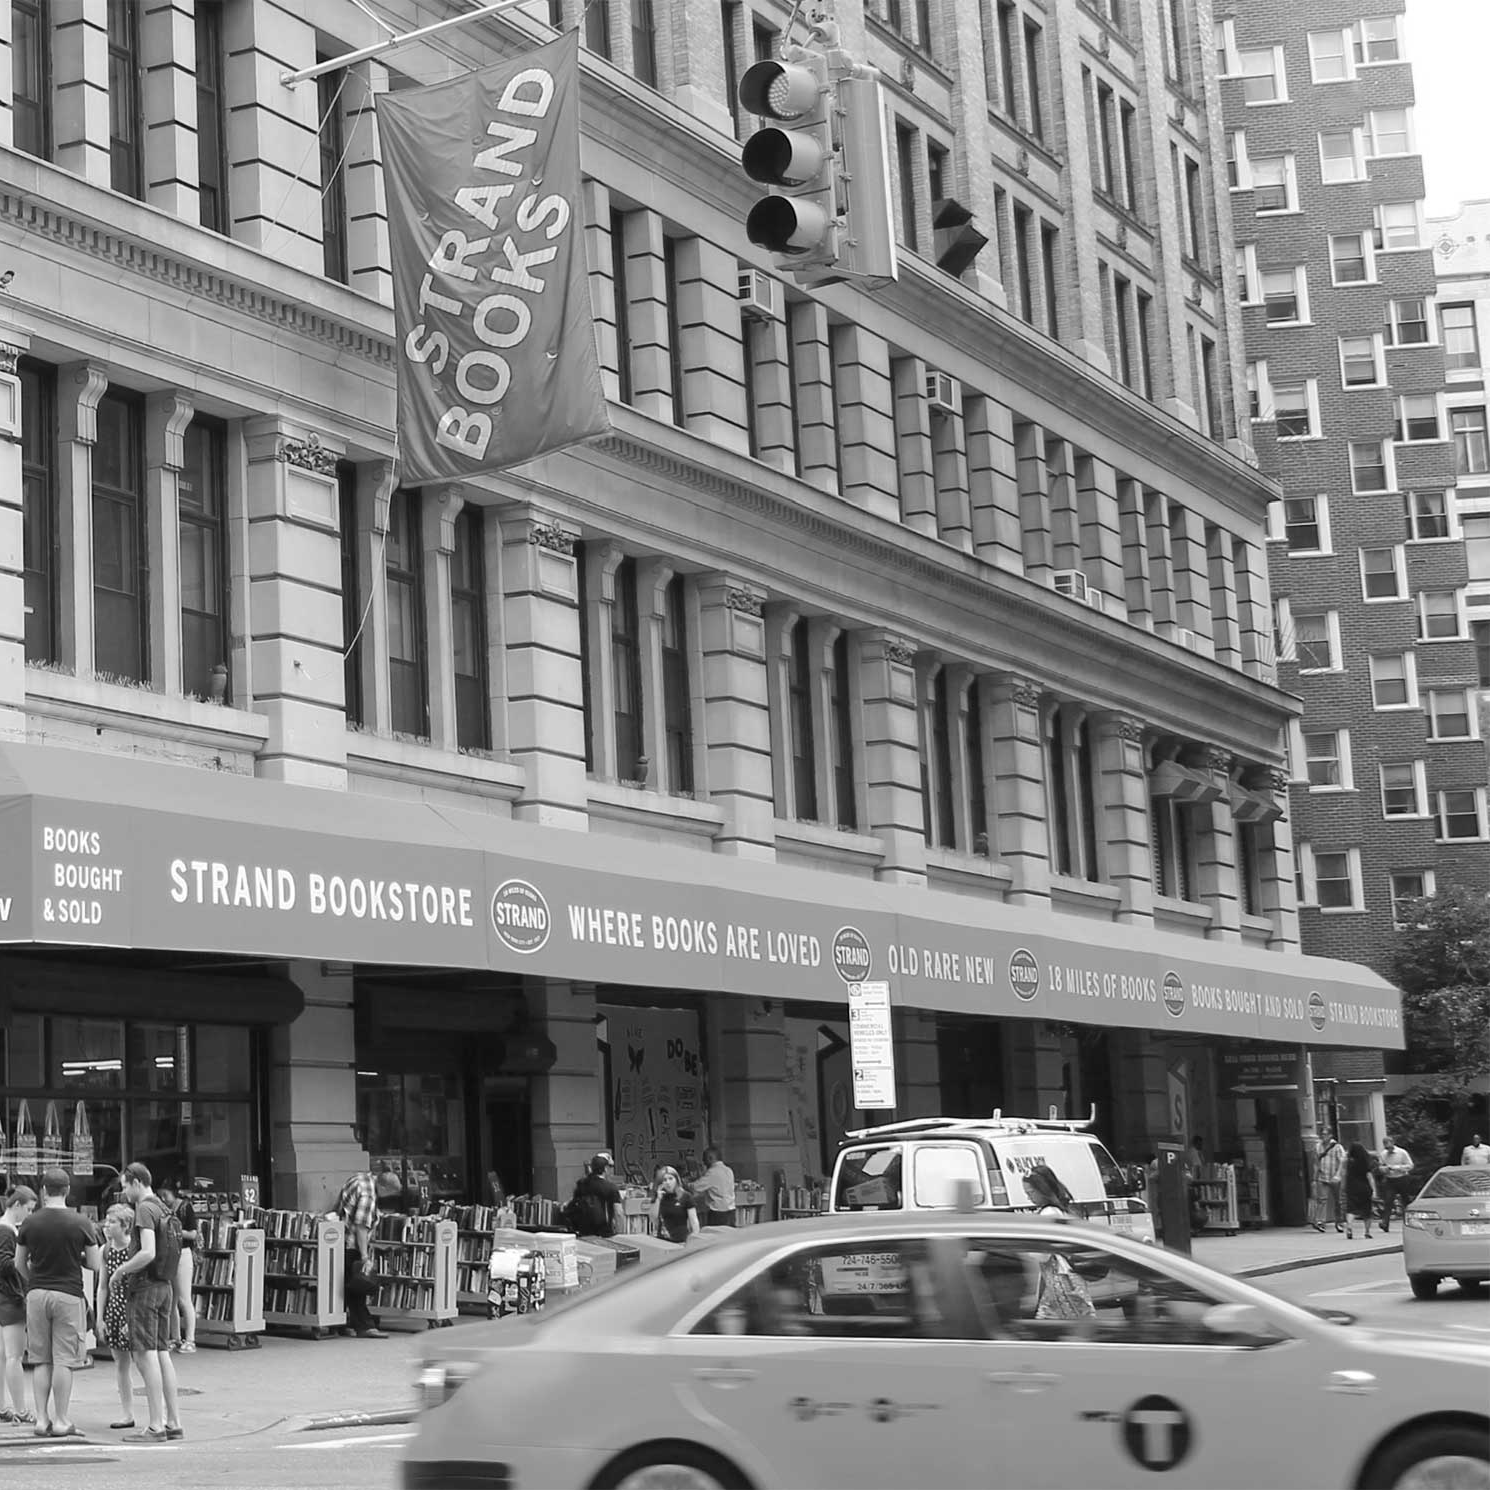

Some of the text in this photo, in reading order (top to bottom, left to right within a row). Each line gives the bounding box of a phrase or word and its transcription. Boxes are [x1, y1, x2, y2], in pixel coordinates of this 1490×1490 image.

[405, 68, 555, 375] STRAND
[435, 192, 571, 461] BOOKS
[44, 827, 100, 855] BOOKS
[54, 863, 123, 891] BOUGHT
[170, 859, 473, 926] STRAND BOOKSTORE
[43, 898, 102, 924] & SOLD
[497, 902, 546, 930] STRAND
[568, 905, 820, 967] WHERE BOOKS ARE LOVED
[836, 945, 869, 966] STRAND
[889, 944, 995, 985] OLD RARE NEW
[1011, 966, 1038, 983] STRAND
[1049, 965, 1157, 1002] 18 MILES OF BOOKS
[1163, 986, 1184, 1002] STRAND
[1191, 984, 1304, 1020] BOOKS BOUGHT AND SOLD
[1329, 1002, 1399, 1028] STRAND BOOKSTORE
[667, 1038, 684, 1059] DO
[684, 1050, 698, 1076] BE
[1166, 1152, 1175, 1164] P
[241, 1174, 259, 1182] STRAND
[244, 1188, 256, 1203] $2
